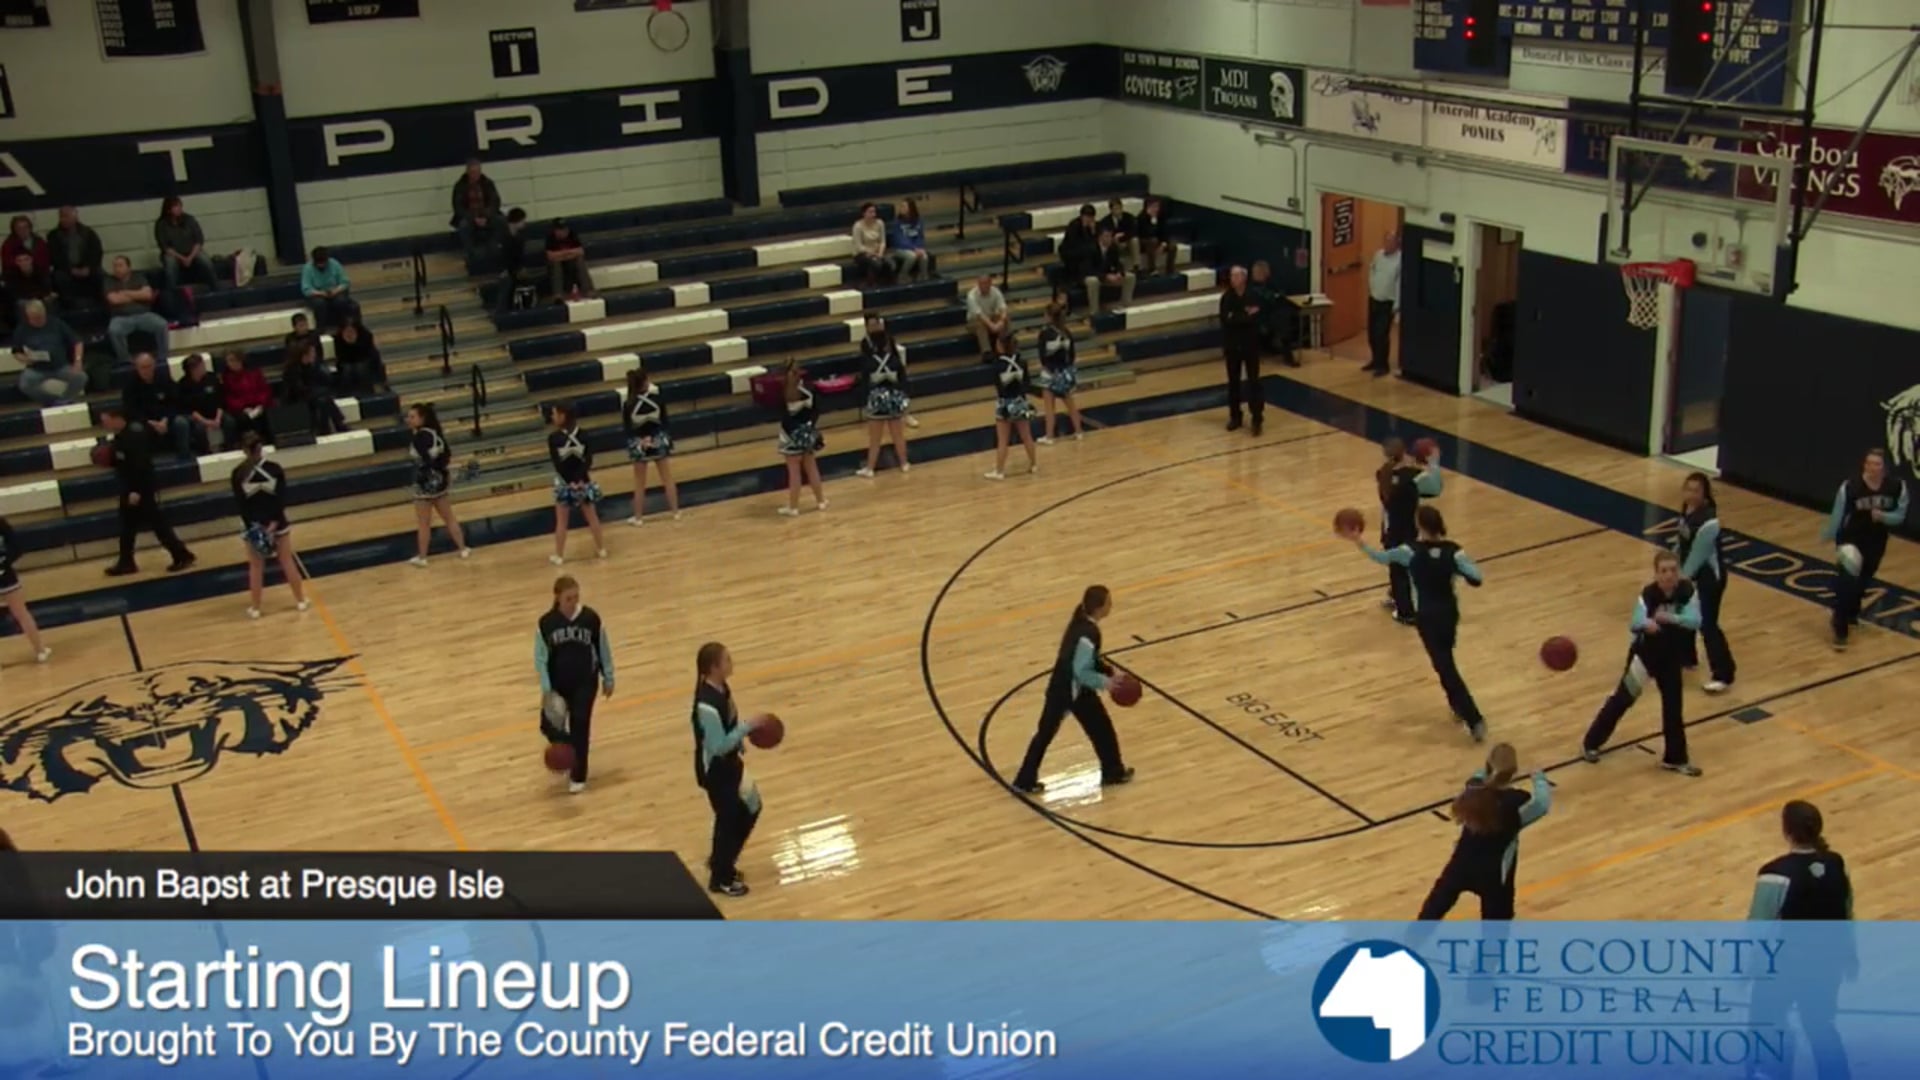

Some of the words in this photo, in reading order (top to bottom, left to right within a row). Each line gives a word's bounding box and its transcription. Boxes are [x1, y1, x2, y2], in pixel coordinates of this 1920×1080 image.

[909, 11, 933, 38] J
[1522, 48, 1562, 63] Donated
[1564, 50, 1577, 65] by
[1578, 51, 1594, 64] the
[1597, 53, 1623, 67] Class
[1124, 74, 1173, 100] COYOTES
[1220, 67, 1249, 90] MDI
[1461, 124, 1505, 143] PONIES
[1756, 131, 1859, 169] Carbou
[1225, 691, 1270, 715] BIG
[1259, 711, 1325, 744] EAST
